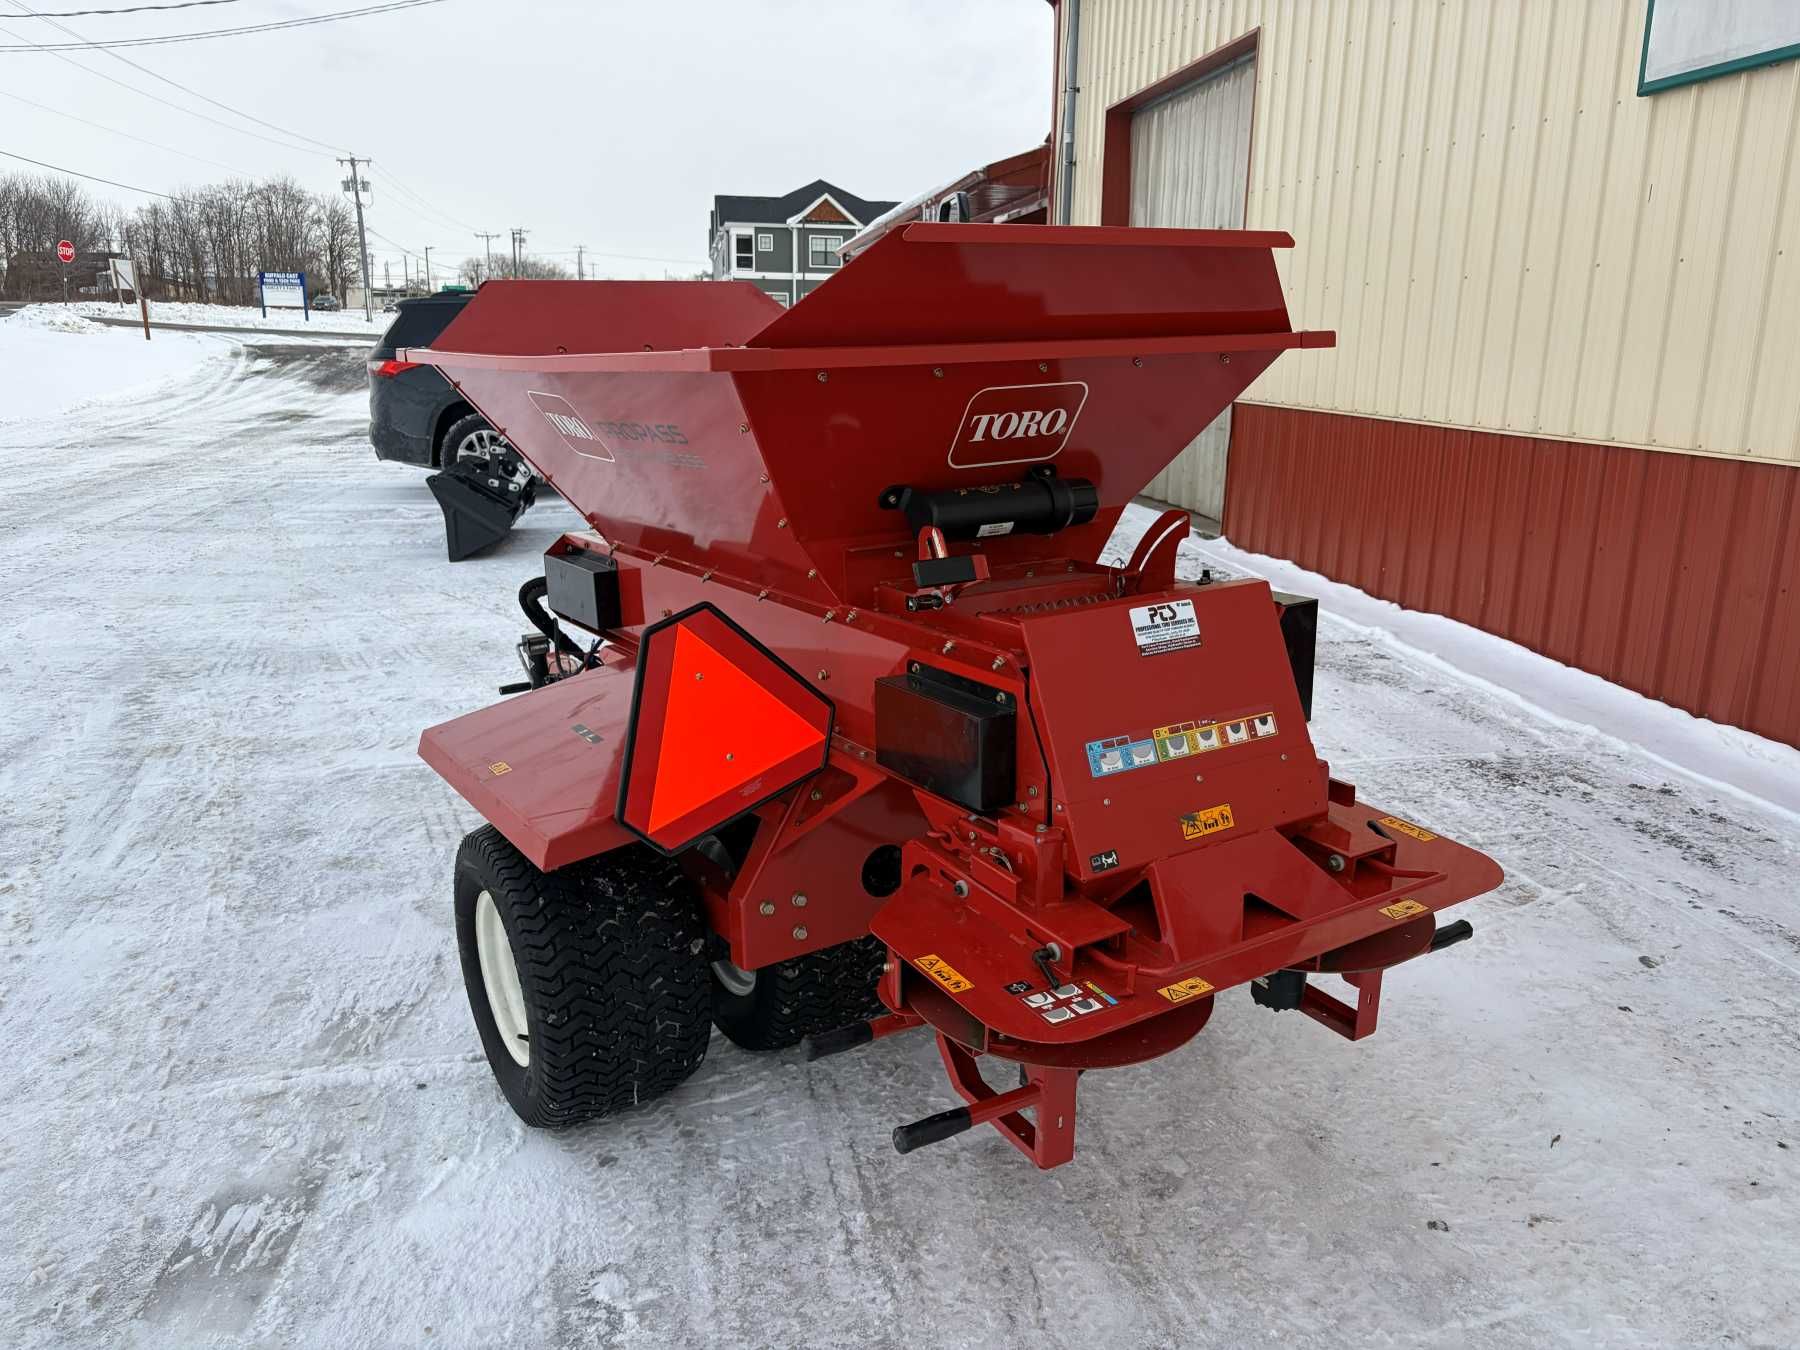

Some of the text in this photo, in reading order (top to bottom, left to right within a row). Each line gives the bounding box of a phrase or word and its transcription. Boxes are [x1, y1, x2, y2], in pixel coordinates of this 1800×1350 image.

[59, 247, 73, 256] STOP
[546, 412, 593, 440] TORO
[968, 408, 1068, 442] TORO
[1147, 604, 1177, 624] PTS
[1135, 623, 1161, 632] PROFESSIONAL
[1171, 619, 1188, 627] SERVICES
